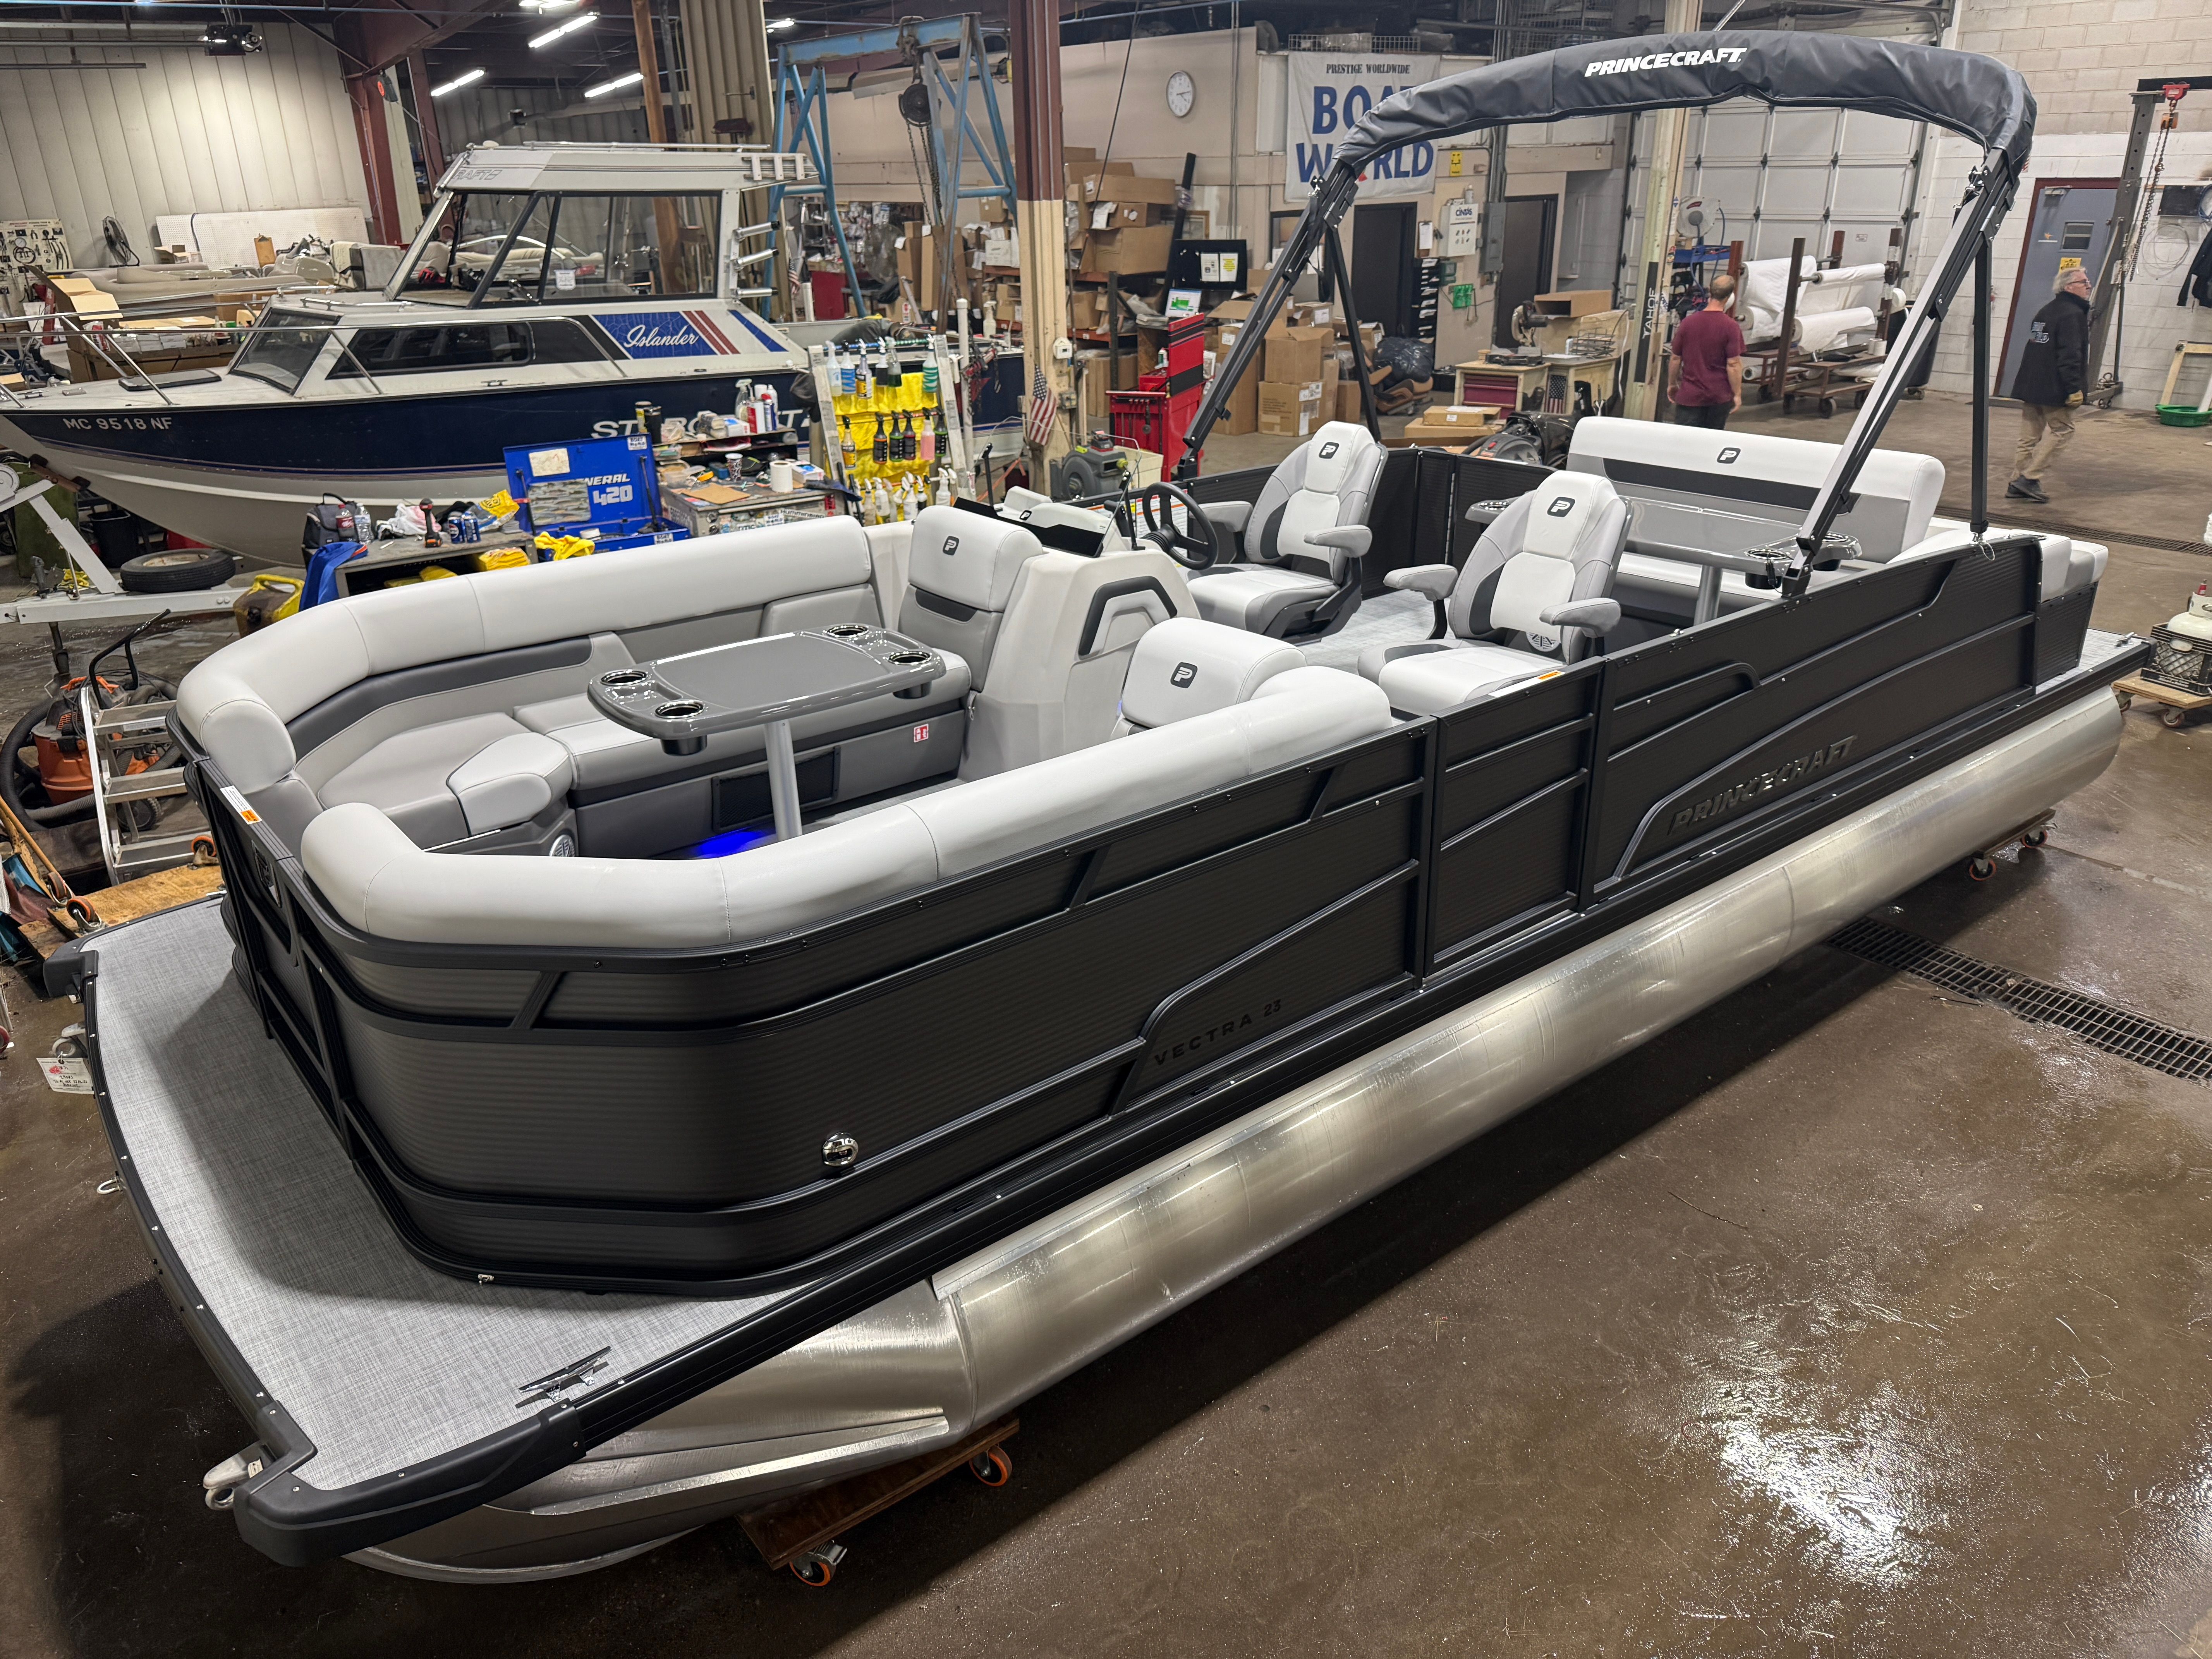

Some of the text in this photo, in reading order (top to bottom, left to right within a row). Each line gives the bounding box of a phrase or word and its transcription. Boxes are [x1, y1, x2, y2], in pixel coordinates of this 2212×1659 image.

[1326, 64, 1410, 74] PRESTIGE WORLDWIDE
[1584, 47, 1748, 77] PRINCECRAFT
[1312, 84, 1416, 134] BO
[1295, 141, 1434, 183] WRLD
[623, 324, 699, 348] Islander
[62, 417, 172, 430] MC 9518 NF
[576, 473, 631, 486] NERAL
[592, 484, 633, 506] 420
[1667, 735, 1858, 835] PRINCECRAFT
[1154, 998, 1282, 1066] VECTRA 23
